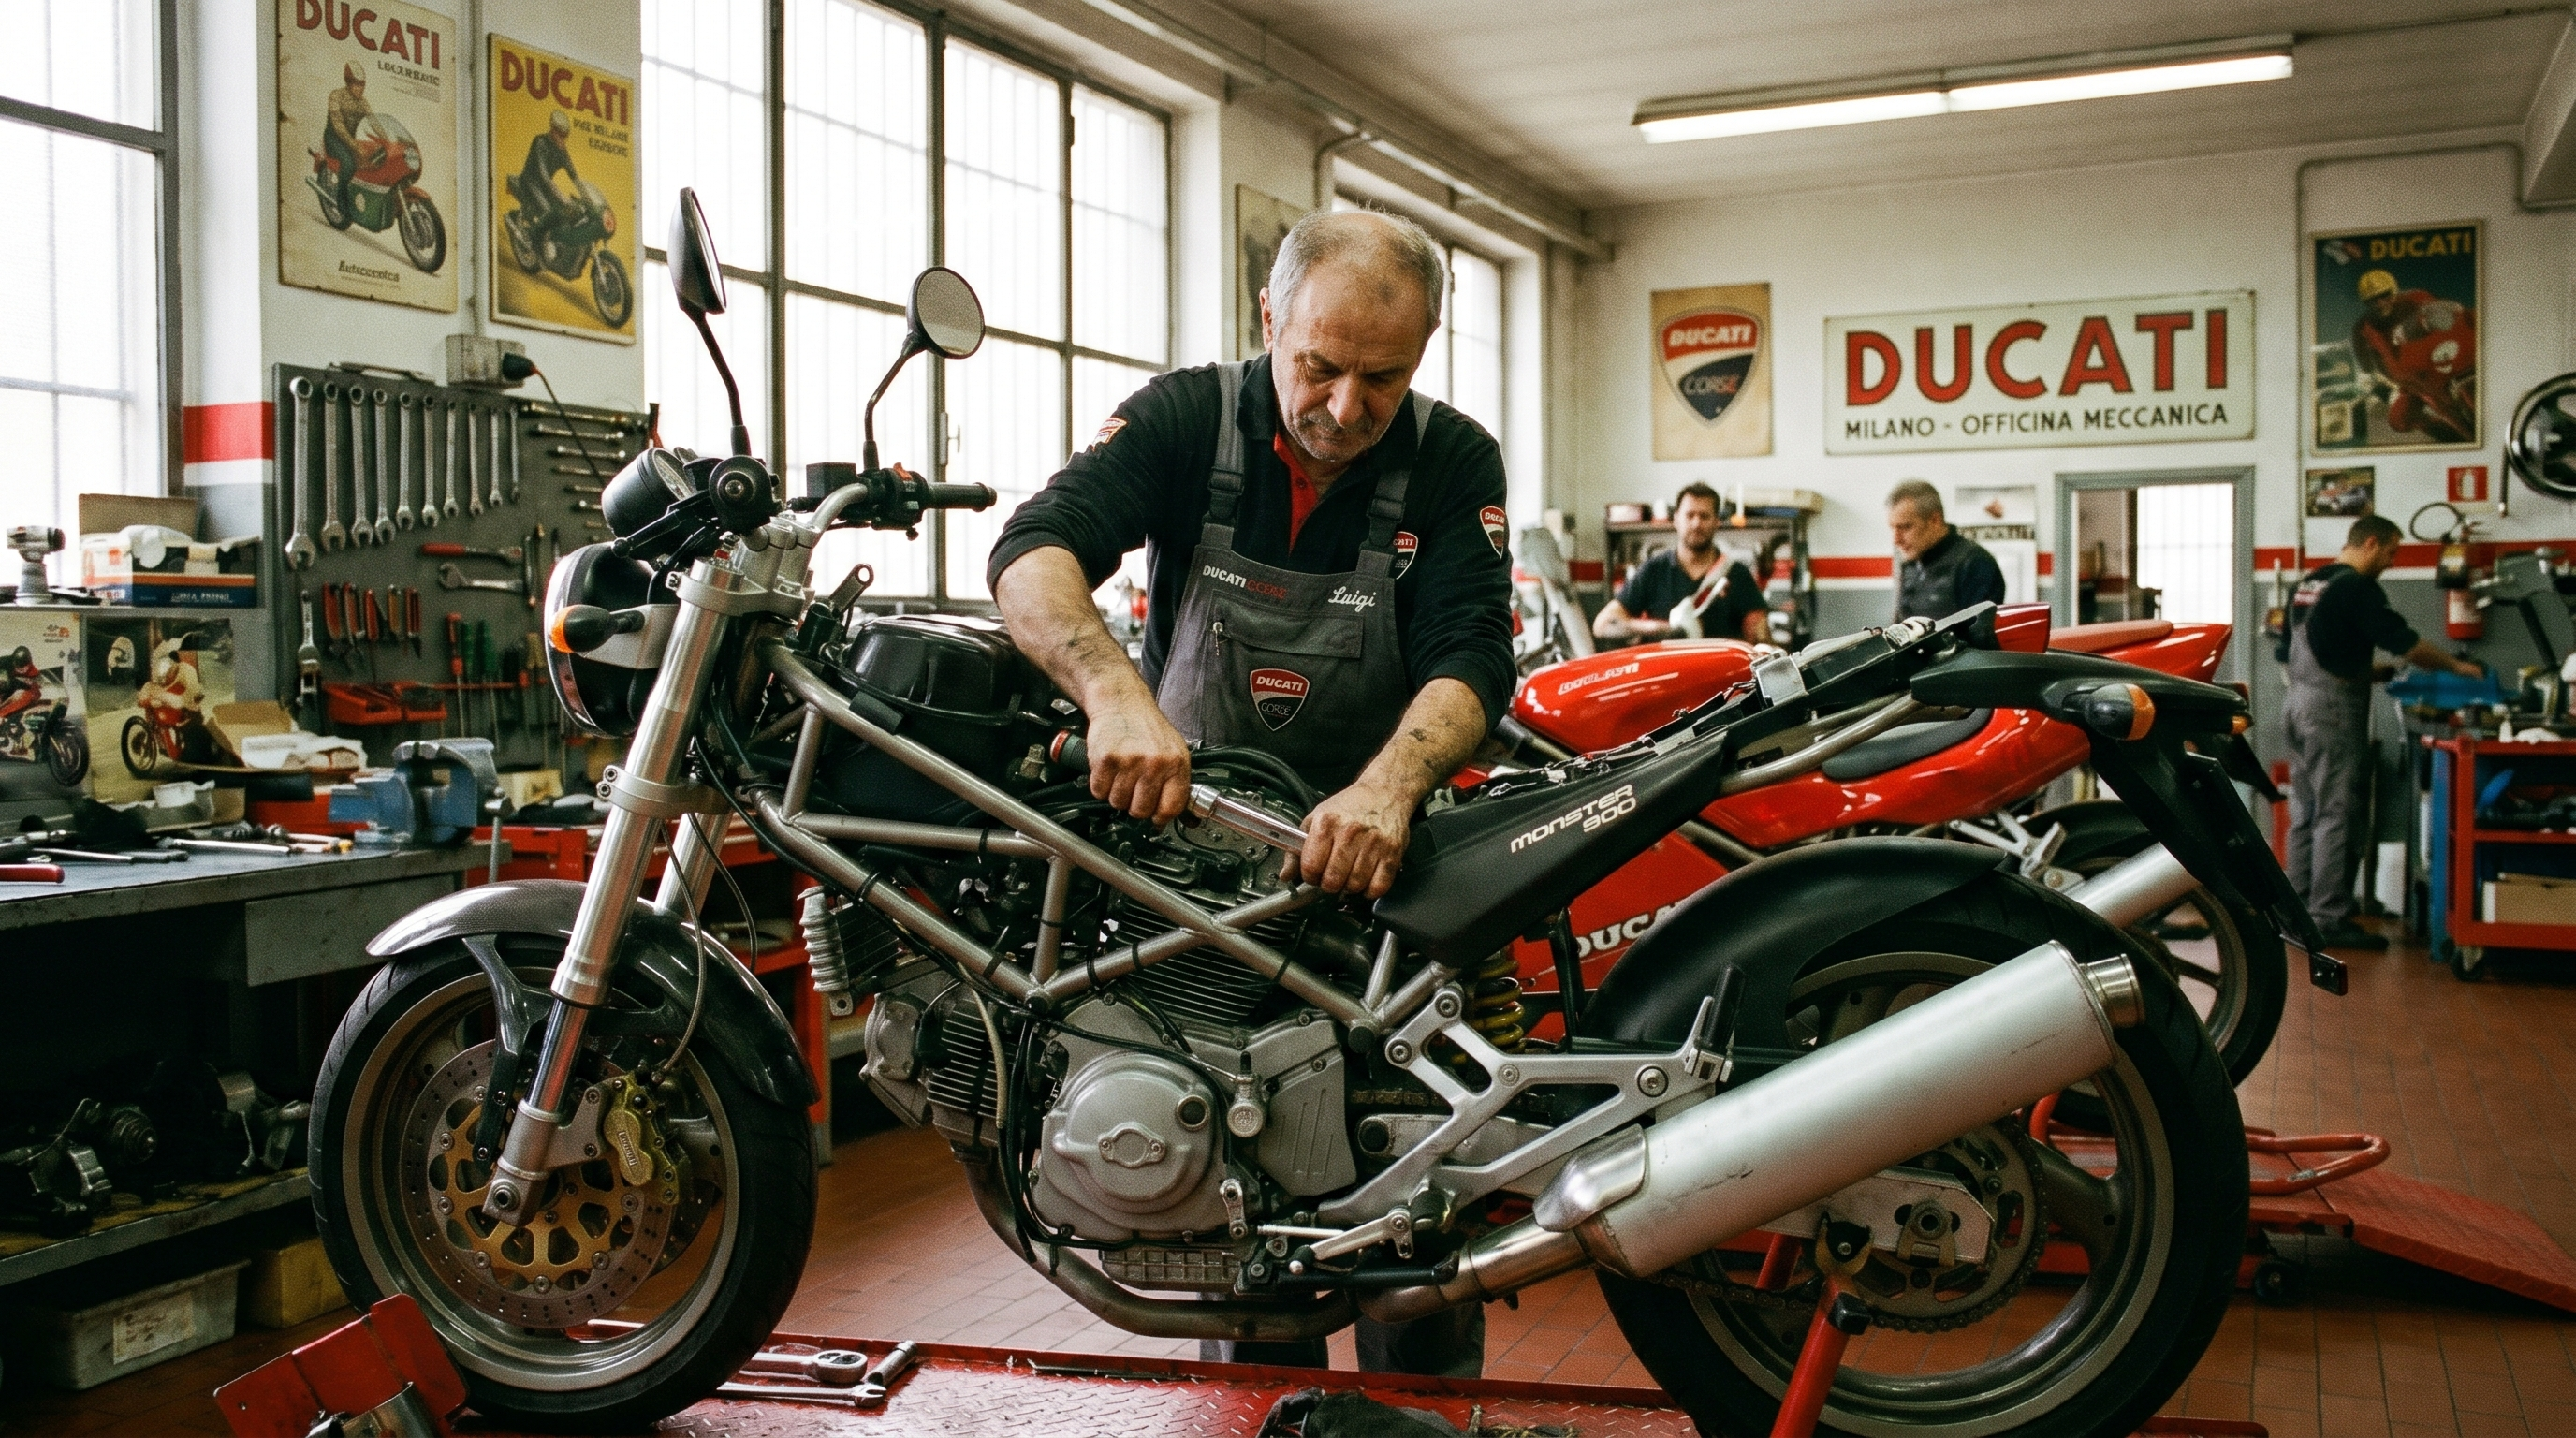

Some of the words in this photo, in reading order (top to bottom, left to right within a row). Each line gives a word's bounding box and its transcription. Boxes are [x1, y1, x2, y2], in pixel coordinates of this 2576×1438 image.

[296, 0, 440, 70] DUCATI
[500, 49, 628, 126] DUCATI
[2369, 232, 2473, 261] DUCATI
[1668, 324, 1752, 347] DUCATI
[1846, 308, 2228, 406] DUCATI
[1846, 417, 1935, 439] MILANO
[1961, 410, 2073, 435] OFFICINA
[2083, 403, 2228, 432] MECCANICA
[1327, 585, 1376, 613] Luigi
[1255, 676, 1303, 692] DUCATI
[1510, 784, 1633, 853] MONSTER
[1582, 797, 1637, 833] 900
